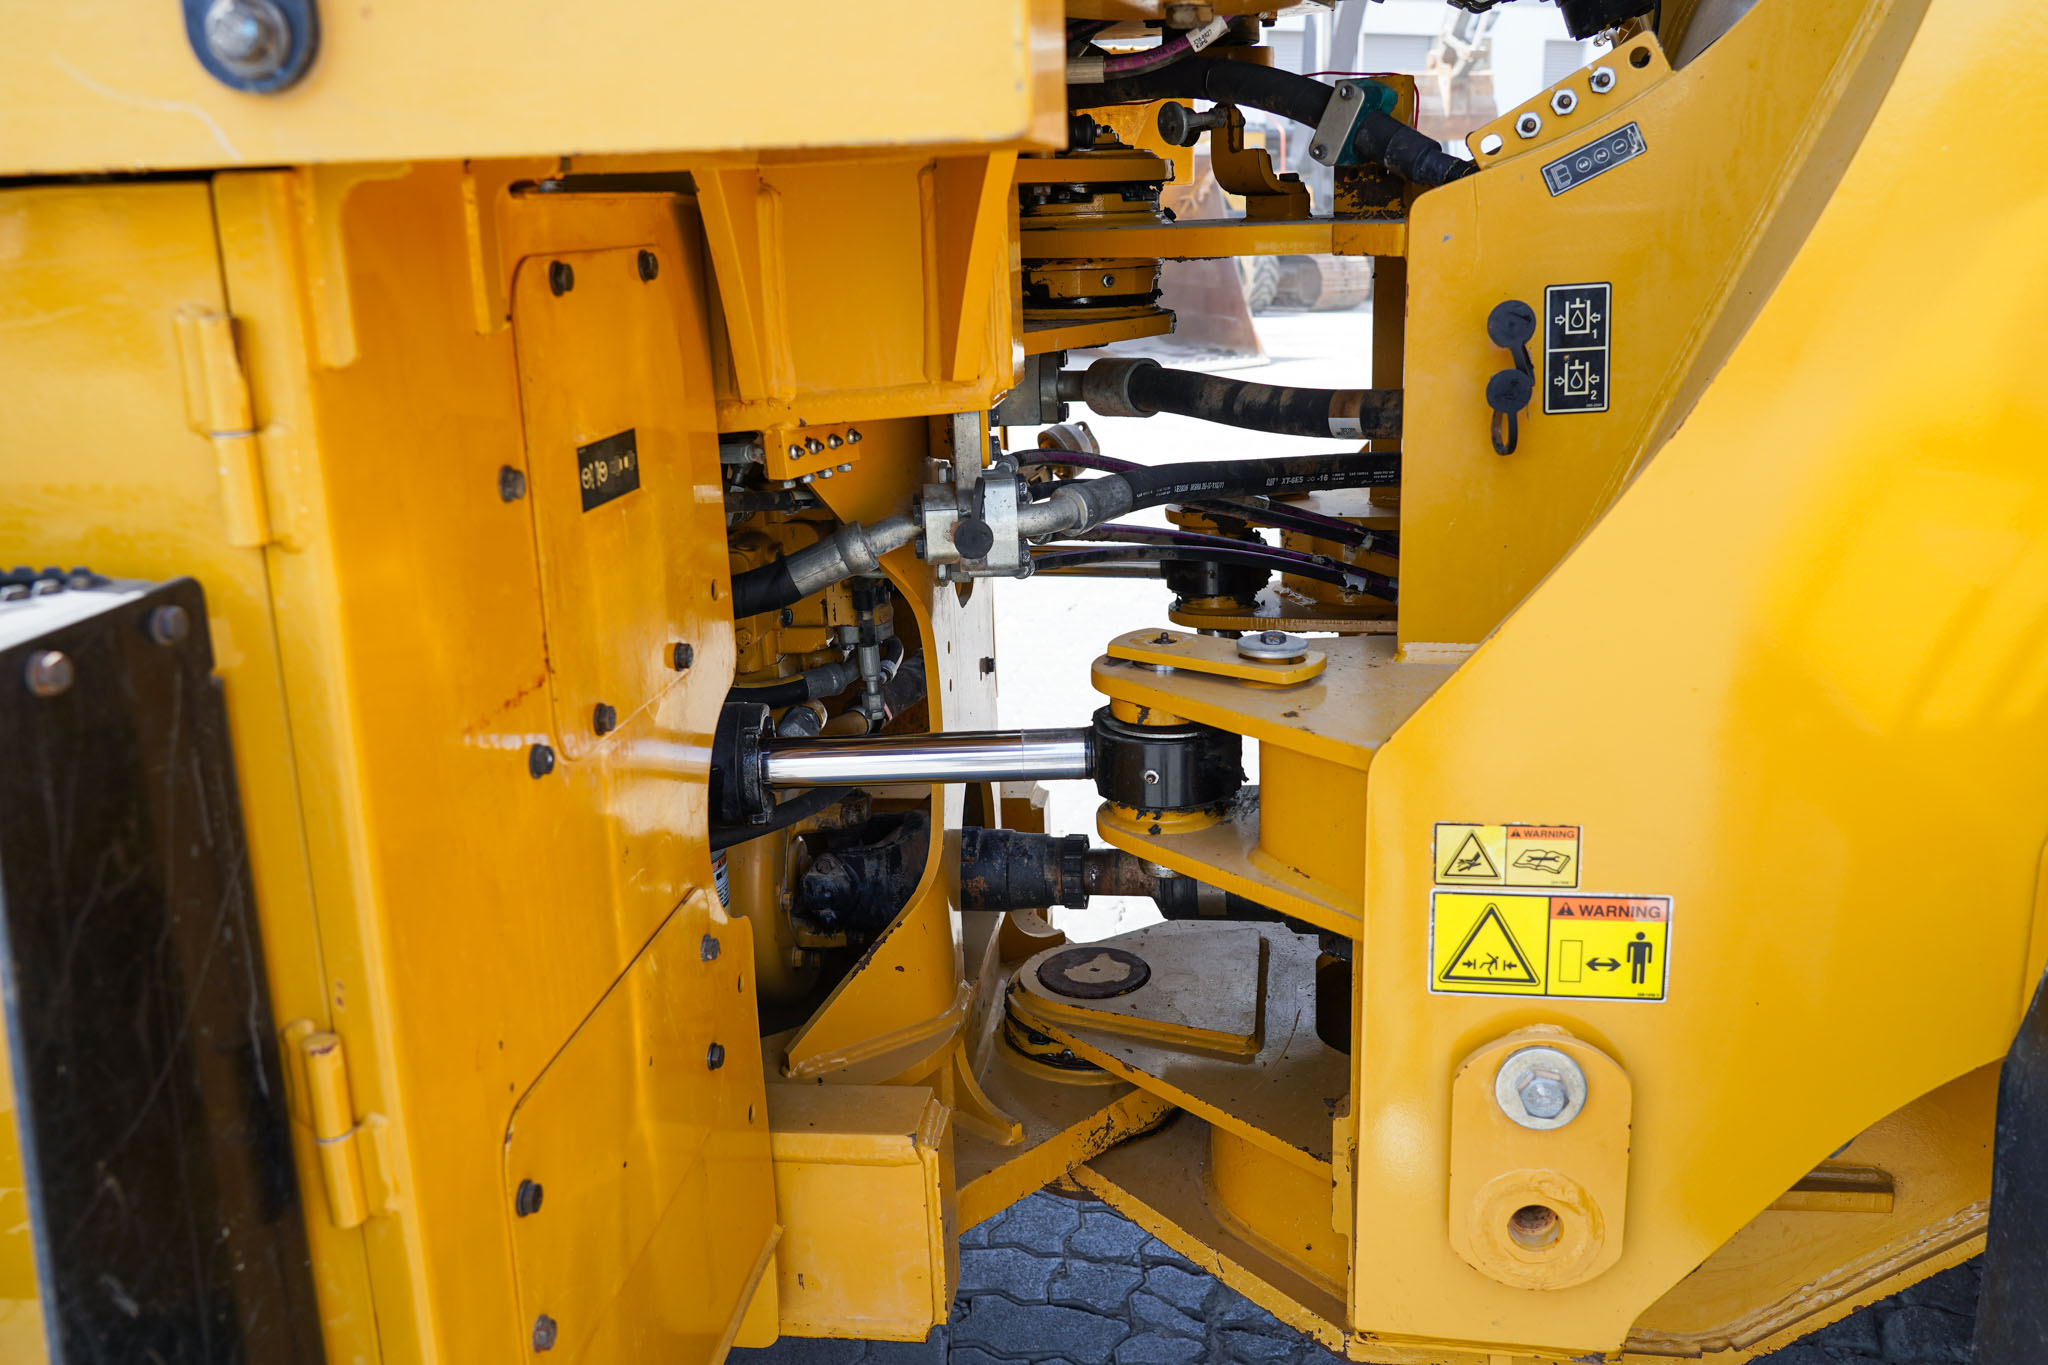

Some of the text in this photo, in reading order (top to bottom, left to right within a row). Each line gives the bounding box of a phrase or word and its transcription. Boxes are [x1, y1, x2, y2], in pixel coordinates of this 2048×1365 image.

[1592, 329, 1597, 339] 1
[1590, 390, 1597, 400] 2
[1523, 829, 1575, 839] WARNING
[1578, 904, 1661, 919] WARNING
